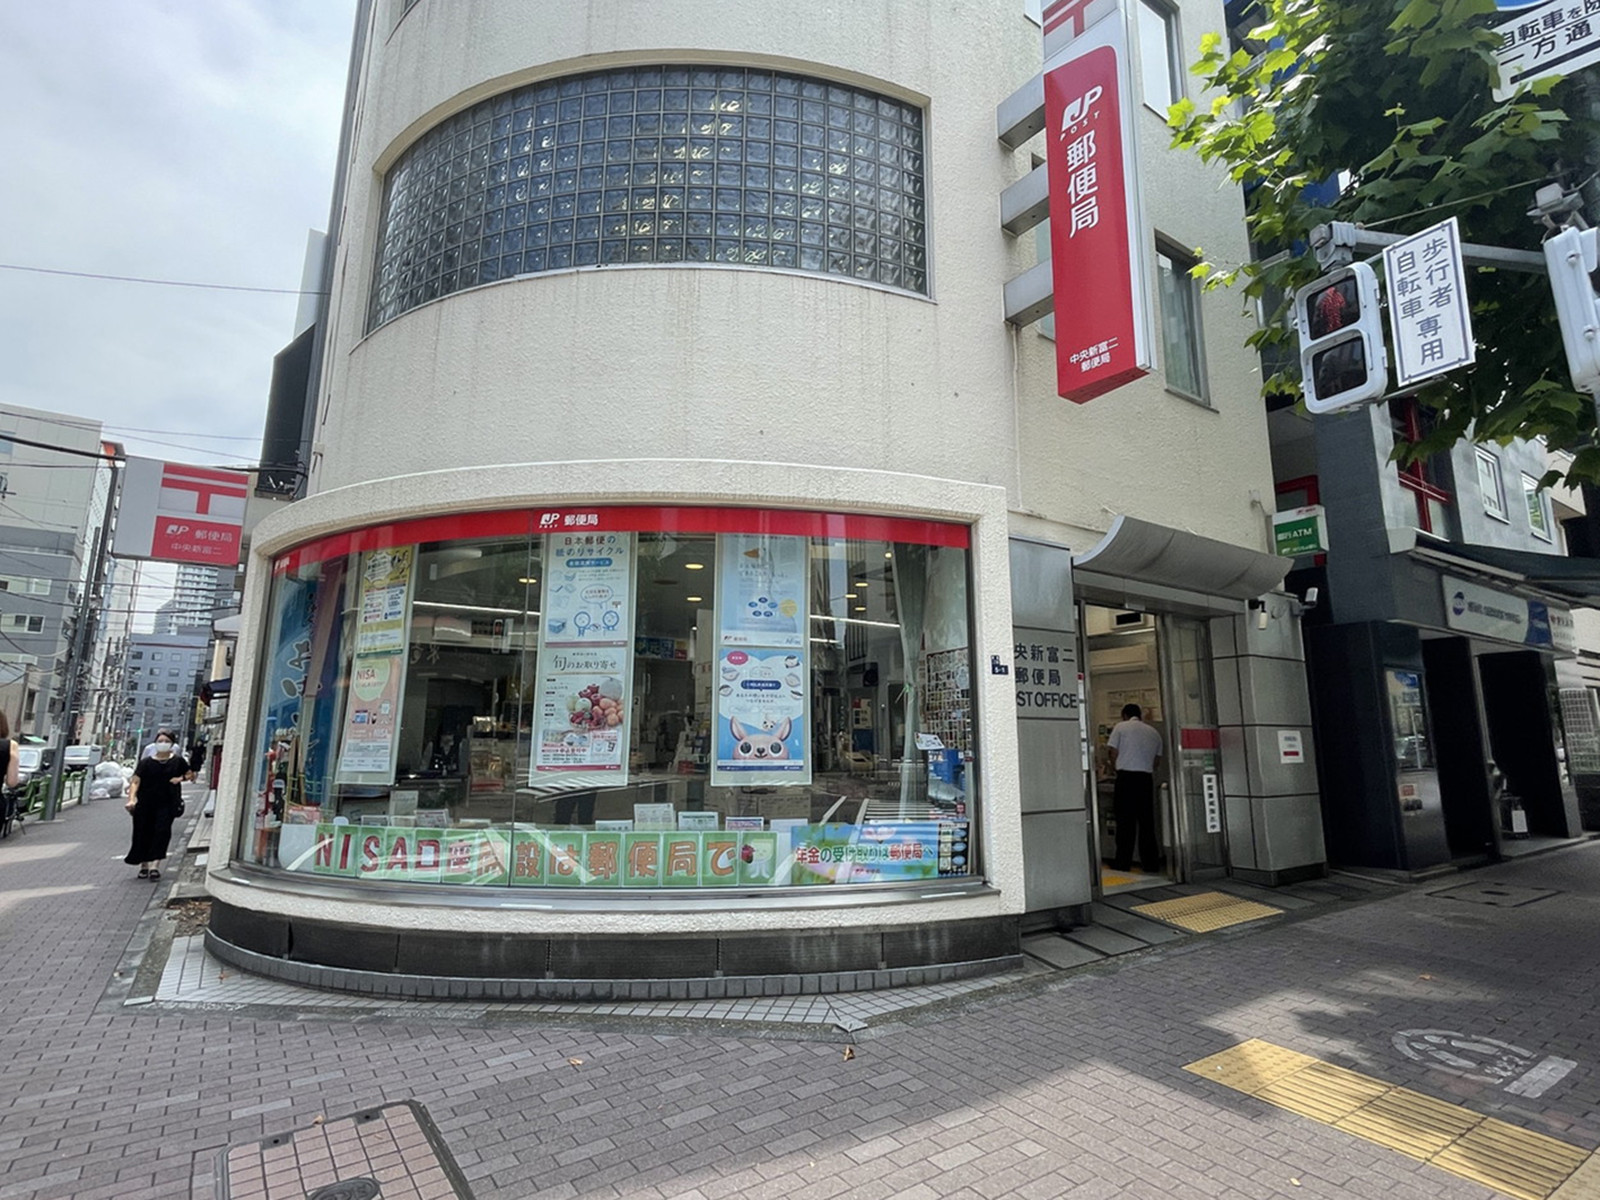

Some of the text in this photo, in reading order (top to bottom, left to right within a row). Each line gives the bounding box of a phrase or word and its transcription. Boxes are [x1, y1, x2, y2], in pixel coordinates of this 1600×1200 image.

[1500, 20, 1592, 65] 一方通
[1060, 110, 1100, 141] POST
[1066, 129, 1099, 239] 郵便局
[1422, 237, 1452, 308] 歩行者
[1397, 251, 1424, 319] 自転車
[1069, 336, 1119, 364] 中央新富二
[1417, 313, 1444, 365] 専用
[1081, 351, 1111, 373] 郵便局
[564, 514, 599, 526] 郵便局
[194, 529, 233, 543] 郵便局
[170, 542, 223, 556] 中央新富二
[553, 655, 617, 671] 旬のお取り寄せ
[357, 669, 375, 680] NISA
[1015, 667, 1061, 686] 郵便局
[1034, 692, 1078, 709] OFFICE
[795, 842, 934, 864] 年金の受け取りは郵便局へ
